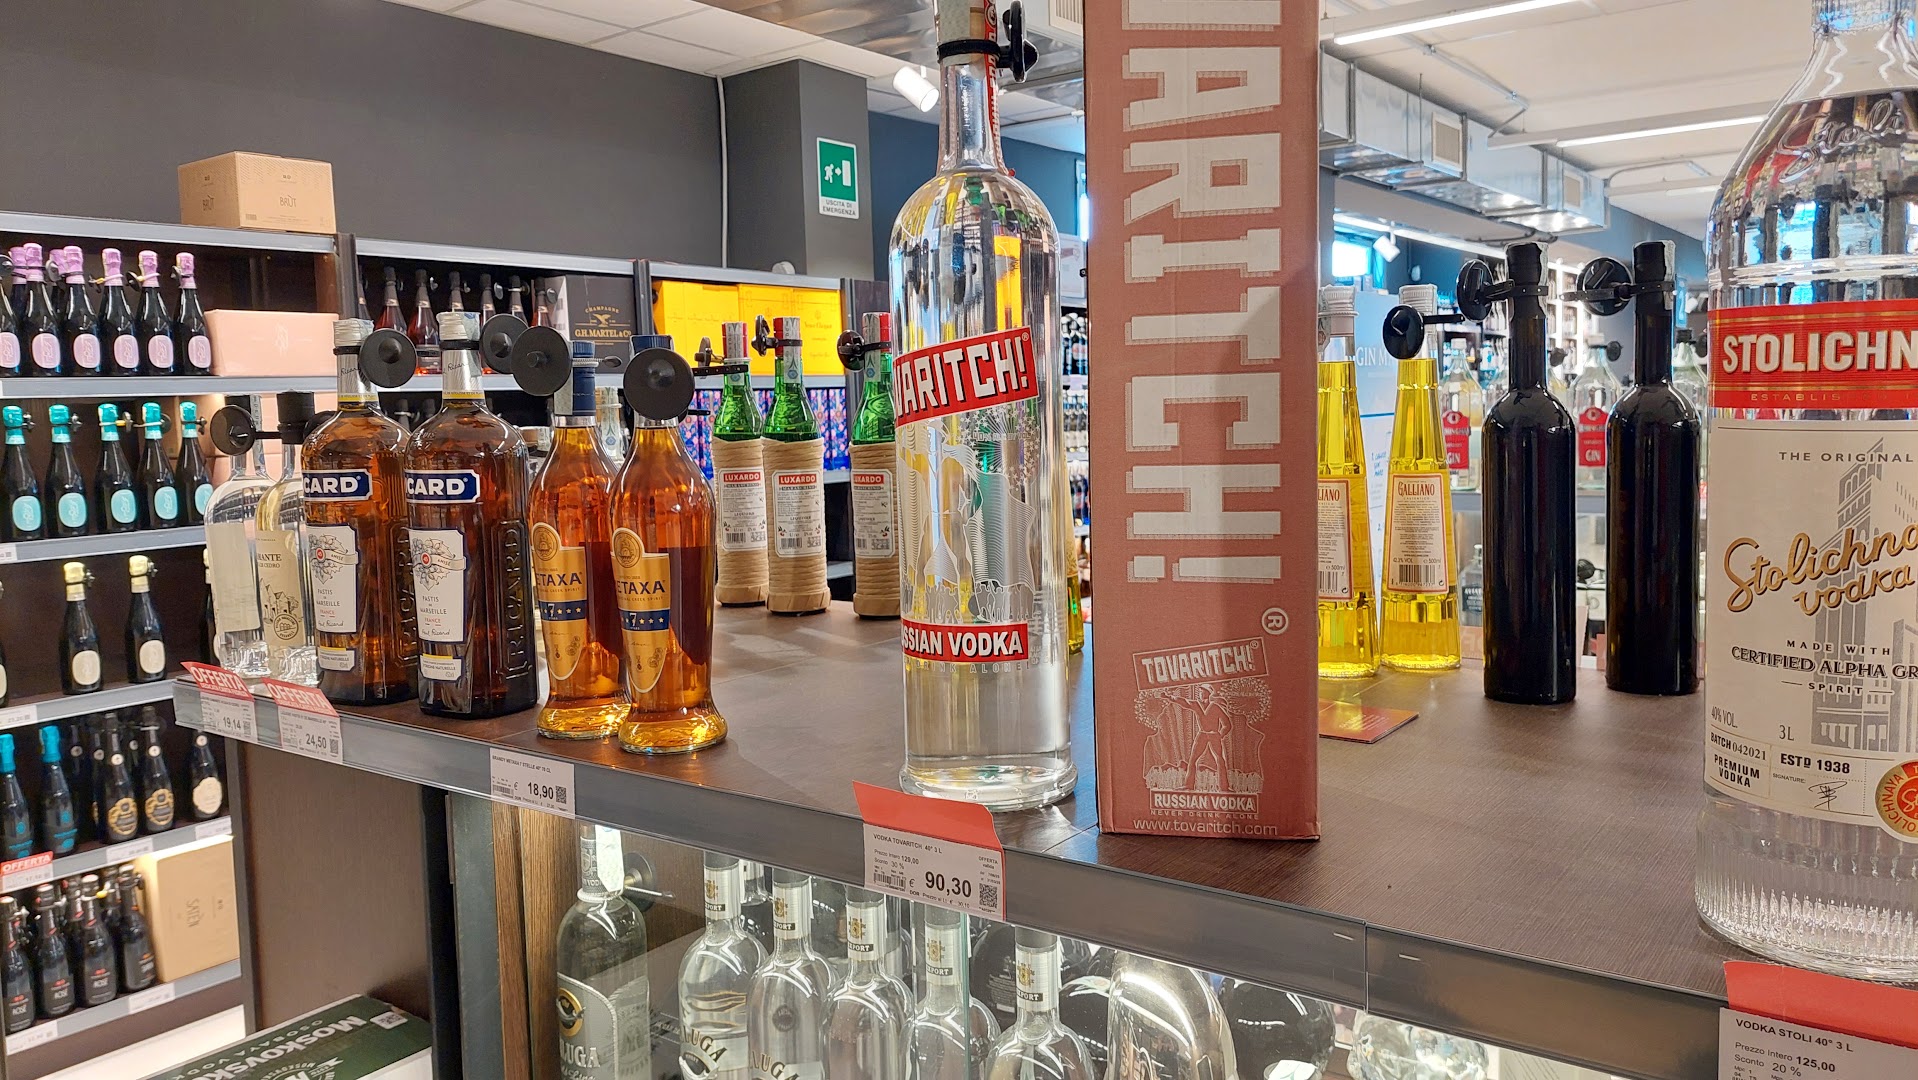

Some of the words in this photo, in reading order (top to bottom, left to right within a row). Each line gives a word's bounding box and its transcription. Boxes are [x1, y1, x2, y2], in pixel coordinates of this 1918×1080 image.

[822, 206, 857, 216] EMERGENZA
[825, 200, 845, 208] USCITA
[1124, 0, 1281, 583] ARITCH!
[1356, 347, 1377, 367] GIN
[1722, 329, 1918, 374] STOLICHN
[1778, 452, 1811, 461] THE
[1821, 453, 1914, 463] ORIGINAL
[304, 476, 358, 494] CARD
[724, 473, 760, 482] LUXARDO
[780, 476, 816, 484] LUXARDO
[407, 478, 466, 496] CARD
[1397, 481, 1436, 497] GALLIANO
[536, 572, 582, 587] ETAXA
[618, 580, 666, 595] ETAXA
[1792, 564, 1916, 616] vodka
[548, 604, 555, 617] 7
[629, 612, 637, 628] 7
[948, 630, 1024, 657] VODKA
[1786, 640, 1832, 652] MADE
[1846, 645, 1890, 656] WITH
[1141, 643, 1256, 684] TOVARITCH!
[1731, 646, 1815, 672] CERTIFIED
[1819, 660, 1888, 678] ALPHA
[190, 666, 248, 692] OFFERTA
[266, 683, 329, 708] OFFERTA
[1808, 683, 1863, 694] SPIRIT
[306, 733, 327, 749] 24,50
[1710, 732, 1732, 750] BATCH
[1714, 754, 1760, 779] PREMIUM
[1816, 760, 1850, 774] 1938
[1718, 766, 1751, 788] VODKA
[528, 782, 554, 800] 18,90
[1154, 794, 1208, 810] RUSSIAN
[1211, 796, 1256, 812] VODKA
[1133, 820, 1278, 836] www.tovaritch.com
[873, 832, 892, 842] VODKA
[892, 838, 922, 850] TOVARITCH
[2, 853, 51, 872] OFFERTA
[909, 878, 916, 888] €
[925, 870, 972, 898] 90,30
[1736, 1018, 1776, 1035] VODKA
[1778, 1028, 1812, 1044] STOLI
[1815, 1036, 1833, 1047] 40°
[1836, 1042, 1842, 1050] 3
[1846, 1043, 1854, 1052] L
[1734, 1054, 1764, 1068] Sconto
[1772, 1062, 1787, 1074] 20
[1790, 1066, 1802, 1077] %
[1735, 1042, 1765, 1056] Prezzo
[1768, 1049, 1793, 1062] Intero
[1796, 1056, 1836, 1072] 125,00
